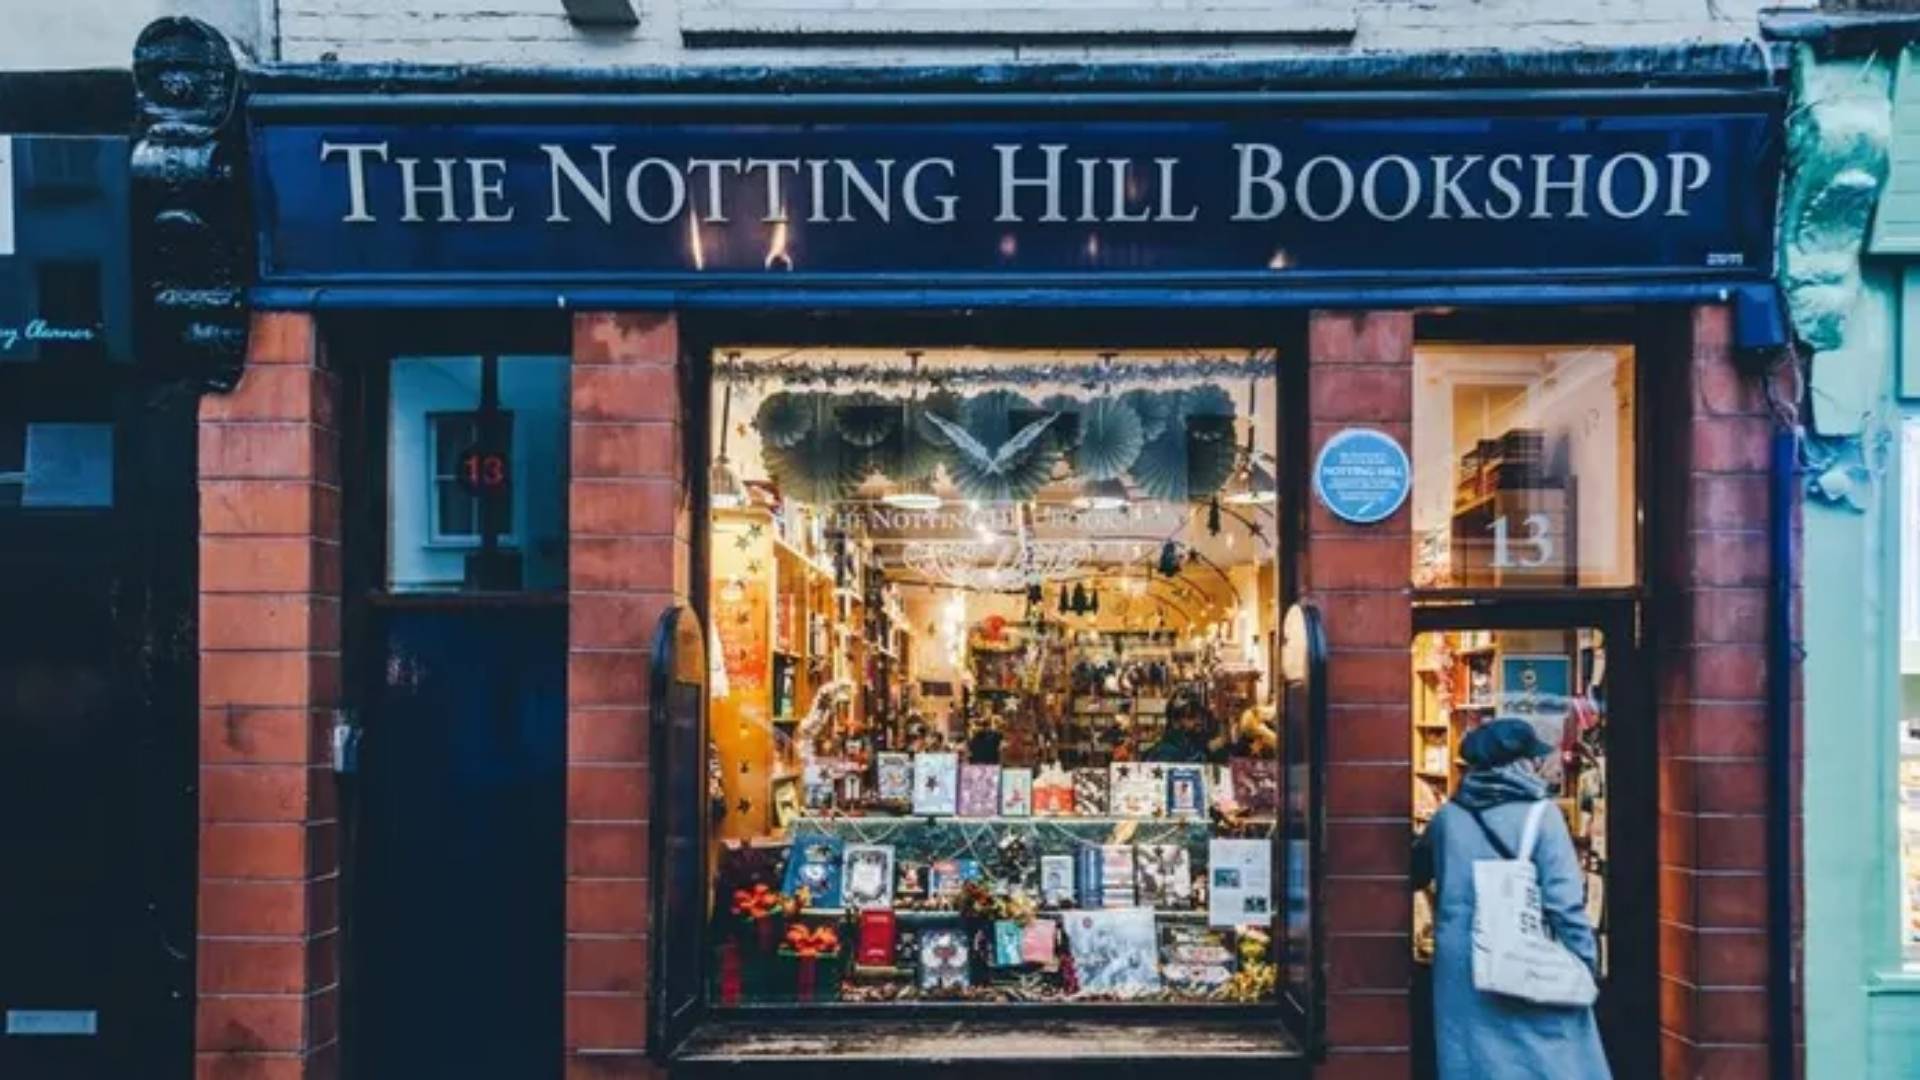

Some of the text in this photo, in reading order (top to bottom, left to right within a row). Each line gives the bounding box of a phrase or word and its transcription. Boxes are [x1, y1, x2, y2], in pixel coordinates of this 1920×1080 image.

[321, 141, 1711, 223] THE NOTTING HILL BOOKSHOP
[464, 454, 504, 486] 13
[1486, 513, 1553, 568] 13
